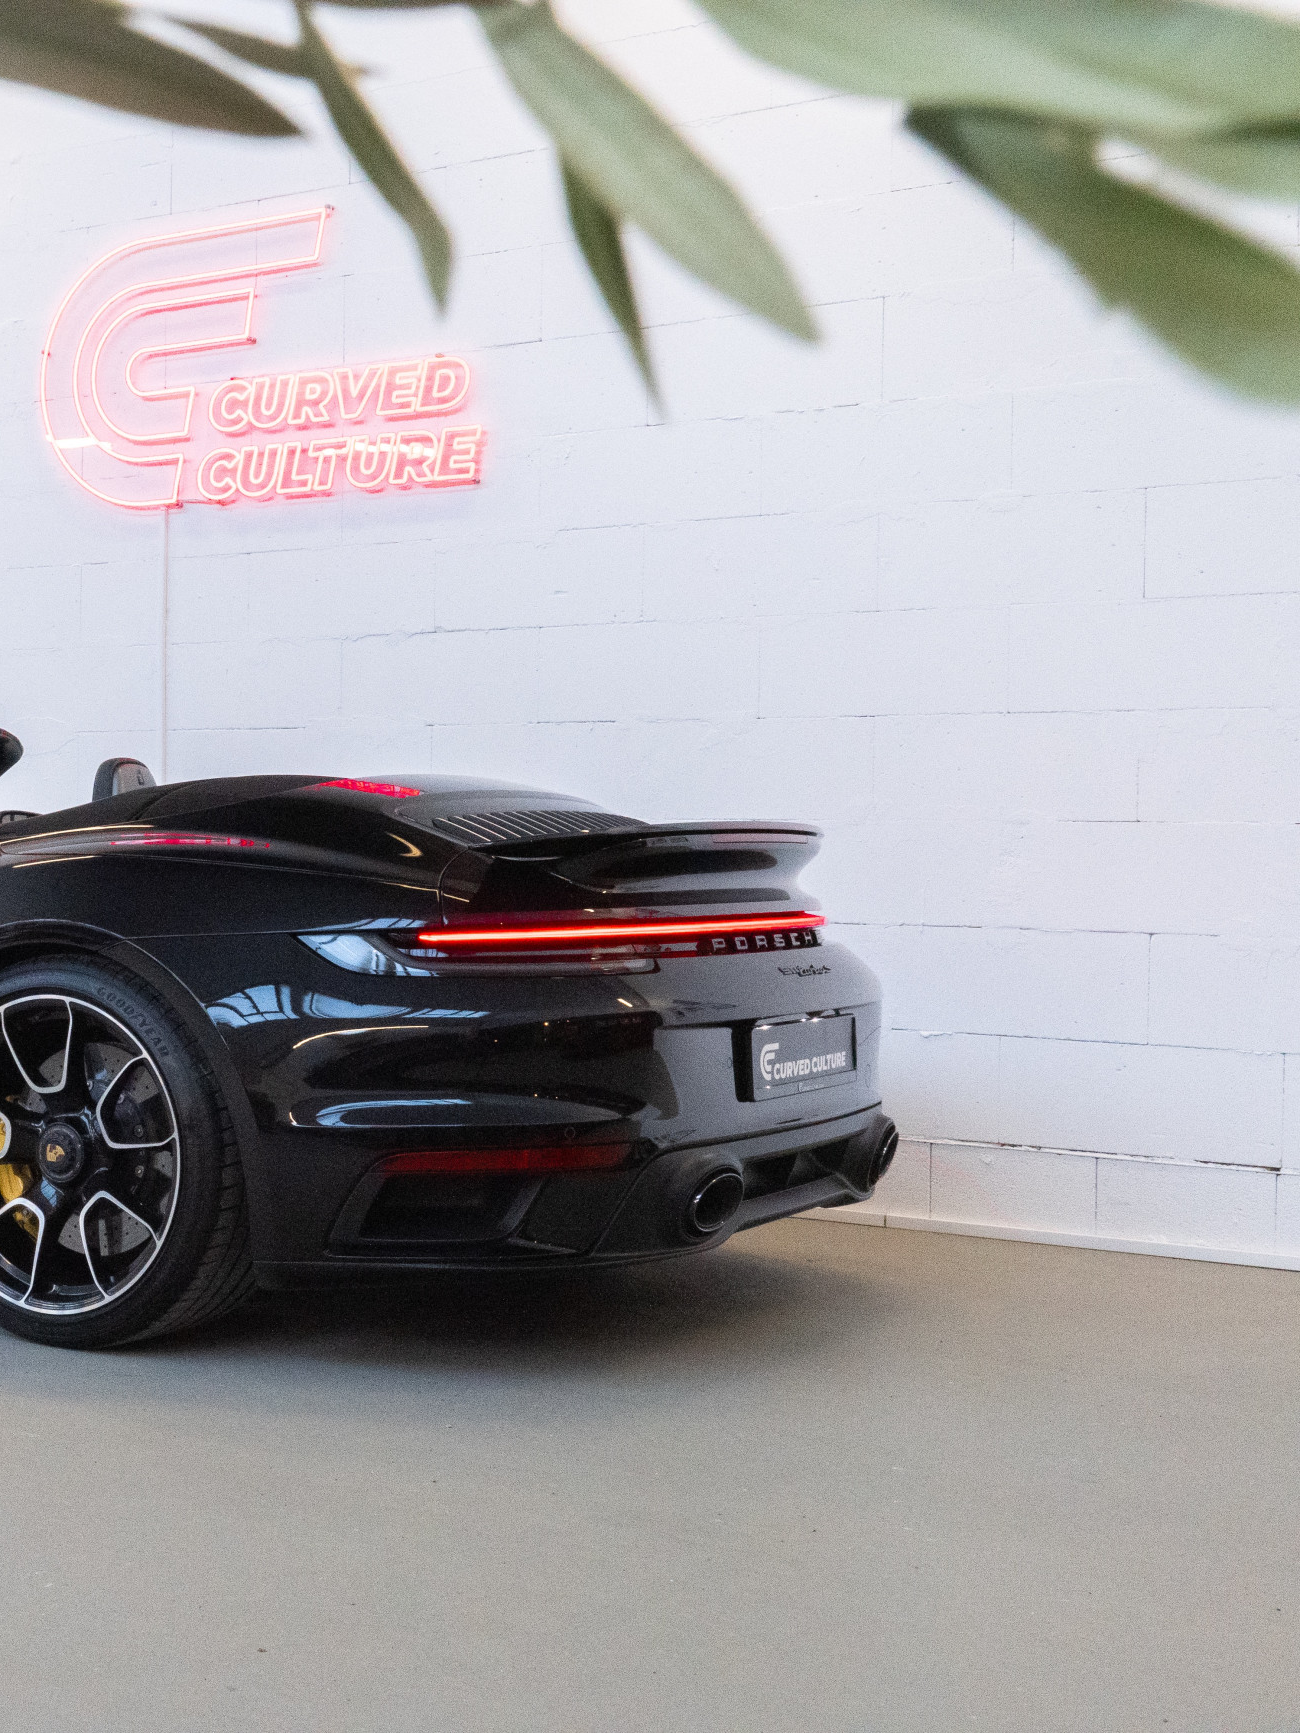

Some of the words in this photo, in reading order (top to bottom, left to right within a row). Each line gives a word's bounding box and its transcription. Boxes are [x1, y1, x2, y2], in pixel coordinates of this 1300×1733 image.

[208, 356, 471, 432] CURVED
[196, 424, 483, 500] CULTURE
[773, 1058, 811, 1080] CURVED
[811, 1051, 846, 1073] CULTURE
